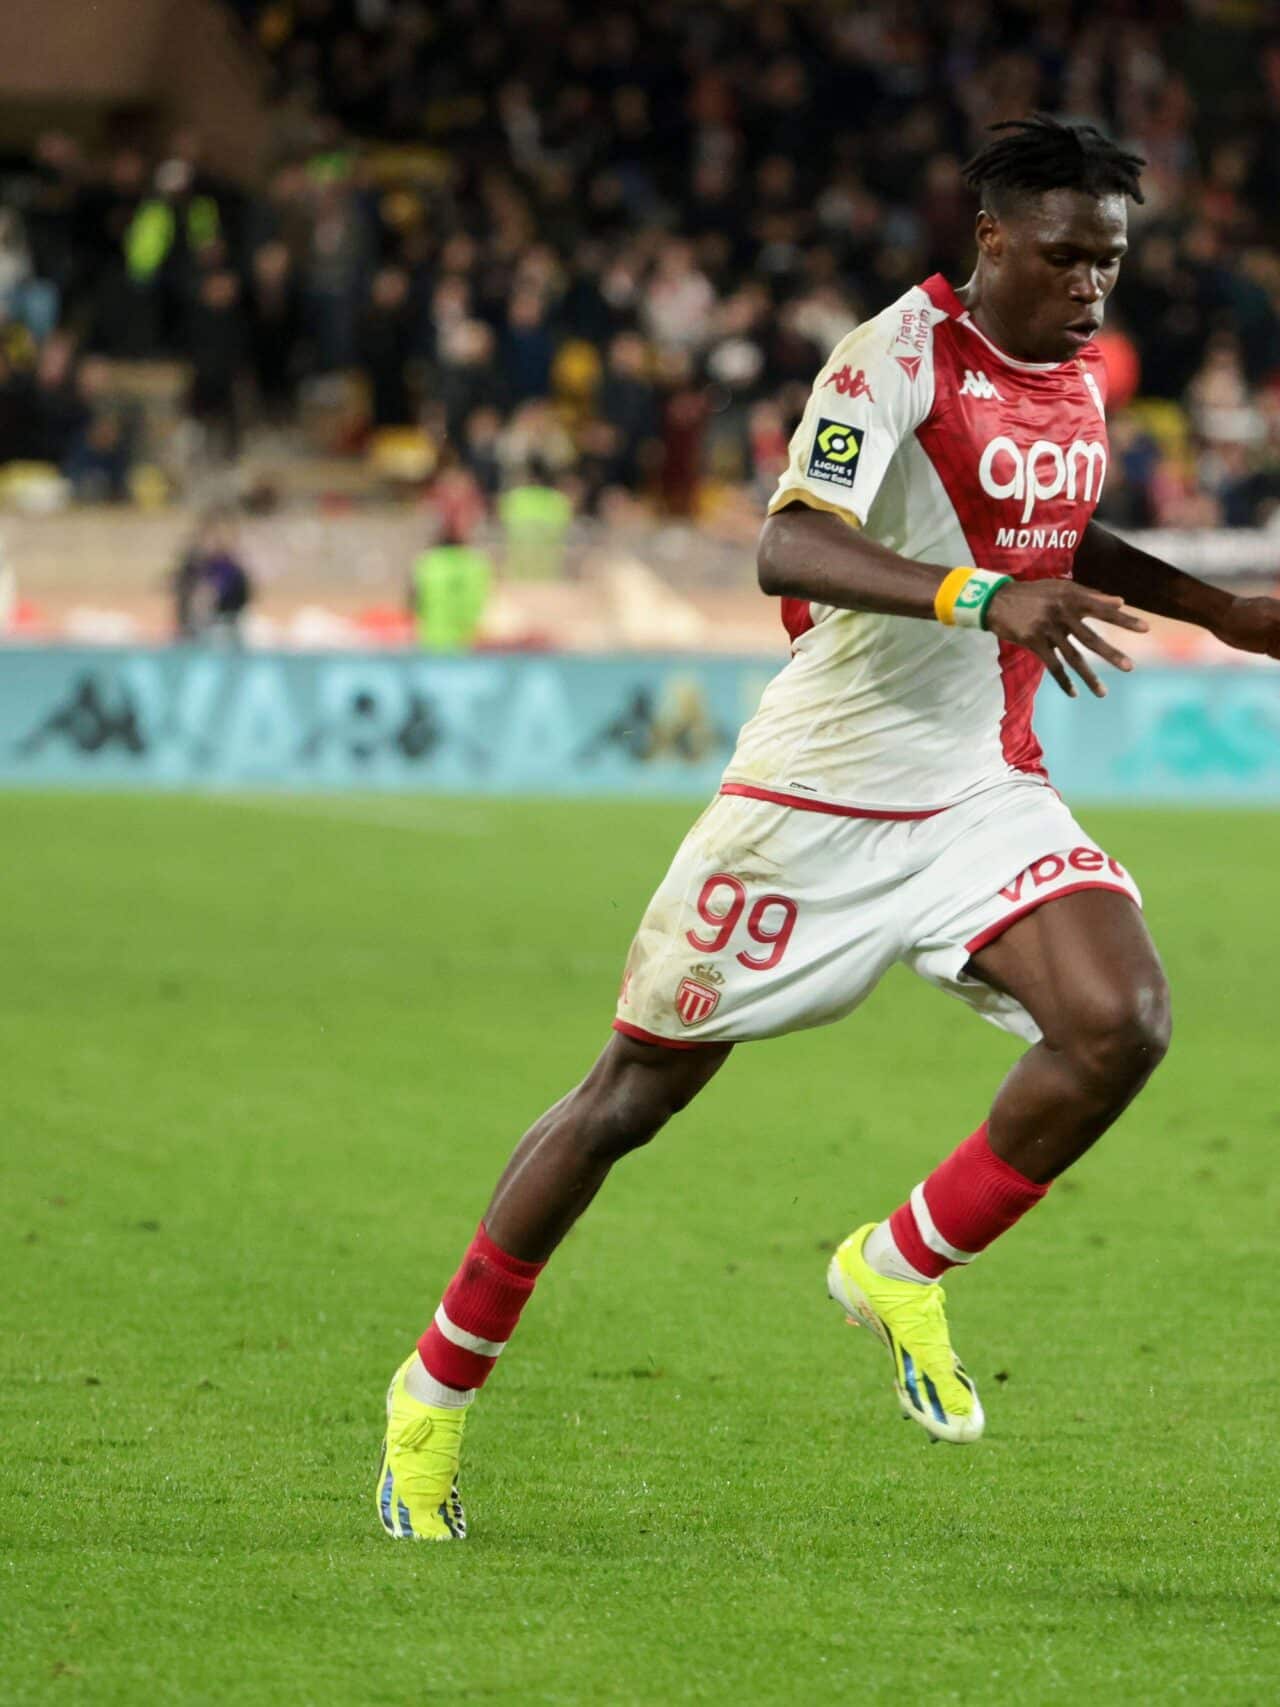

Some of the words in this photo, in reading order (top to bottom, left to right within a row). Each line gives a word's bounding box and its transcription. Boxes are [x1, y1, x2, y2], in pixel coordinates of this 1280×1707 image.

[814, 459, 846, 474] LIGUE
[979, 436, 1107, 524] apm
[995, 527, 1078, 549] MONACO
[686, 872, 799, 971] 99
